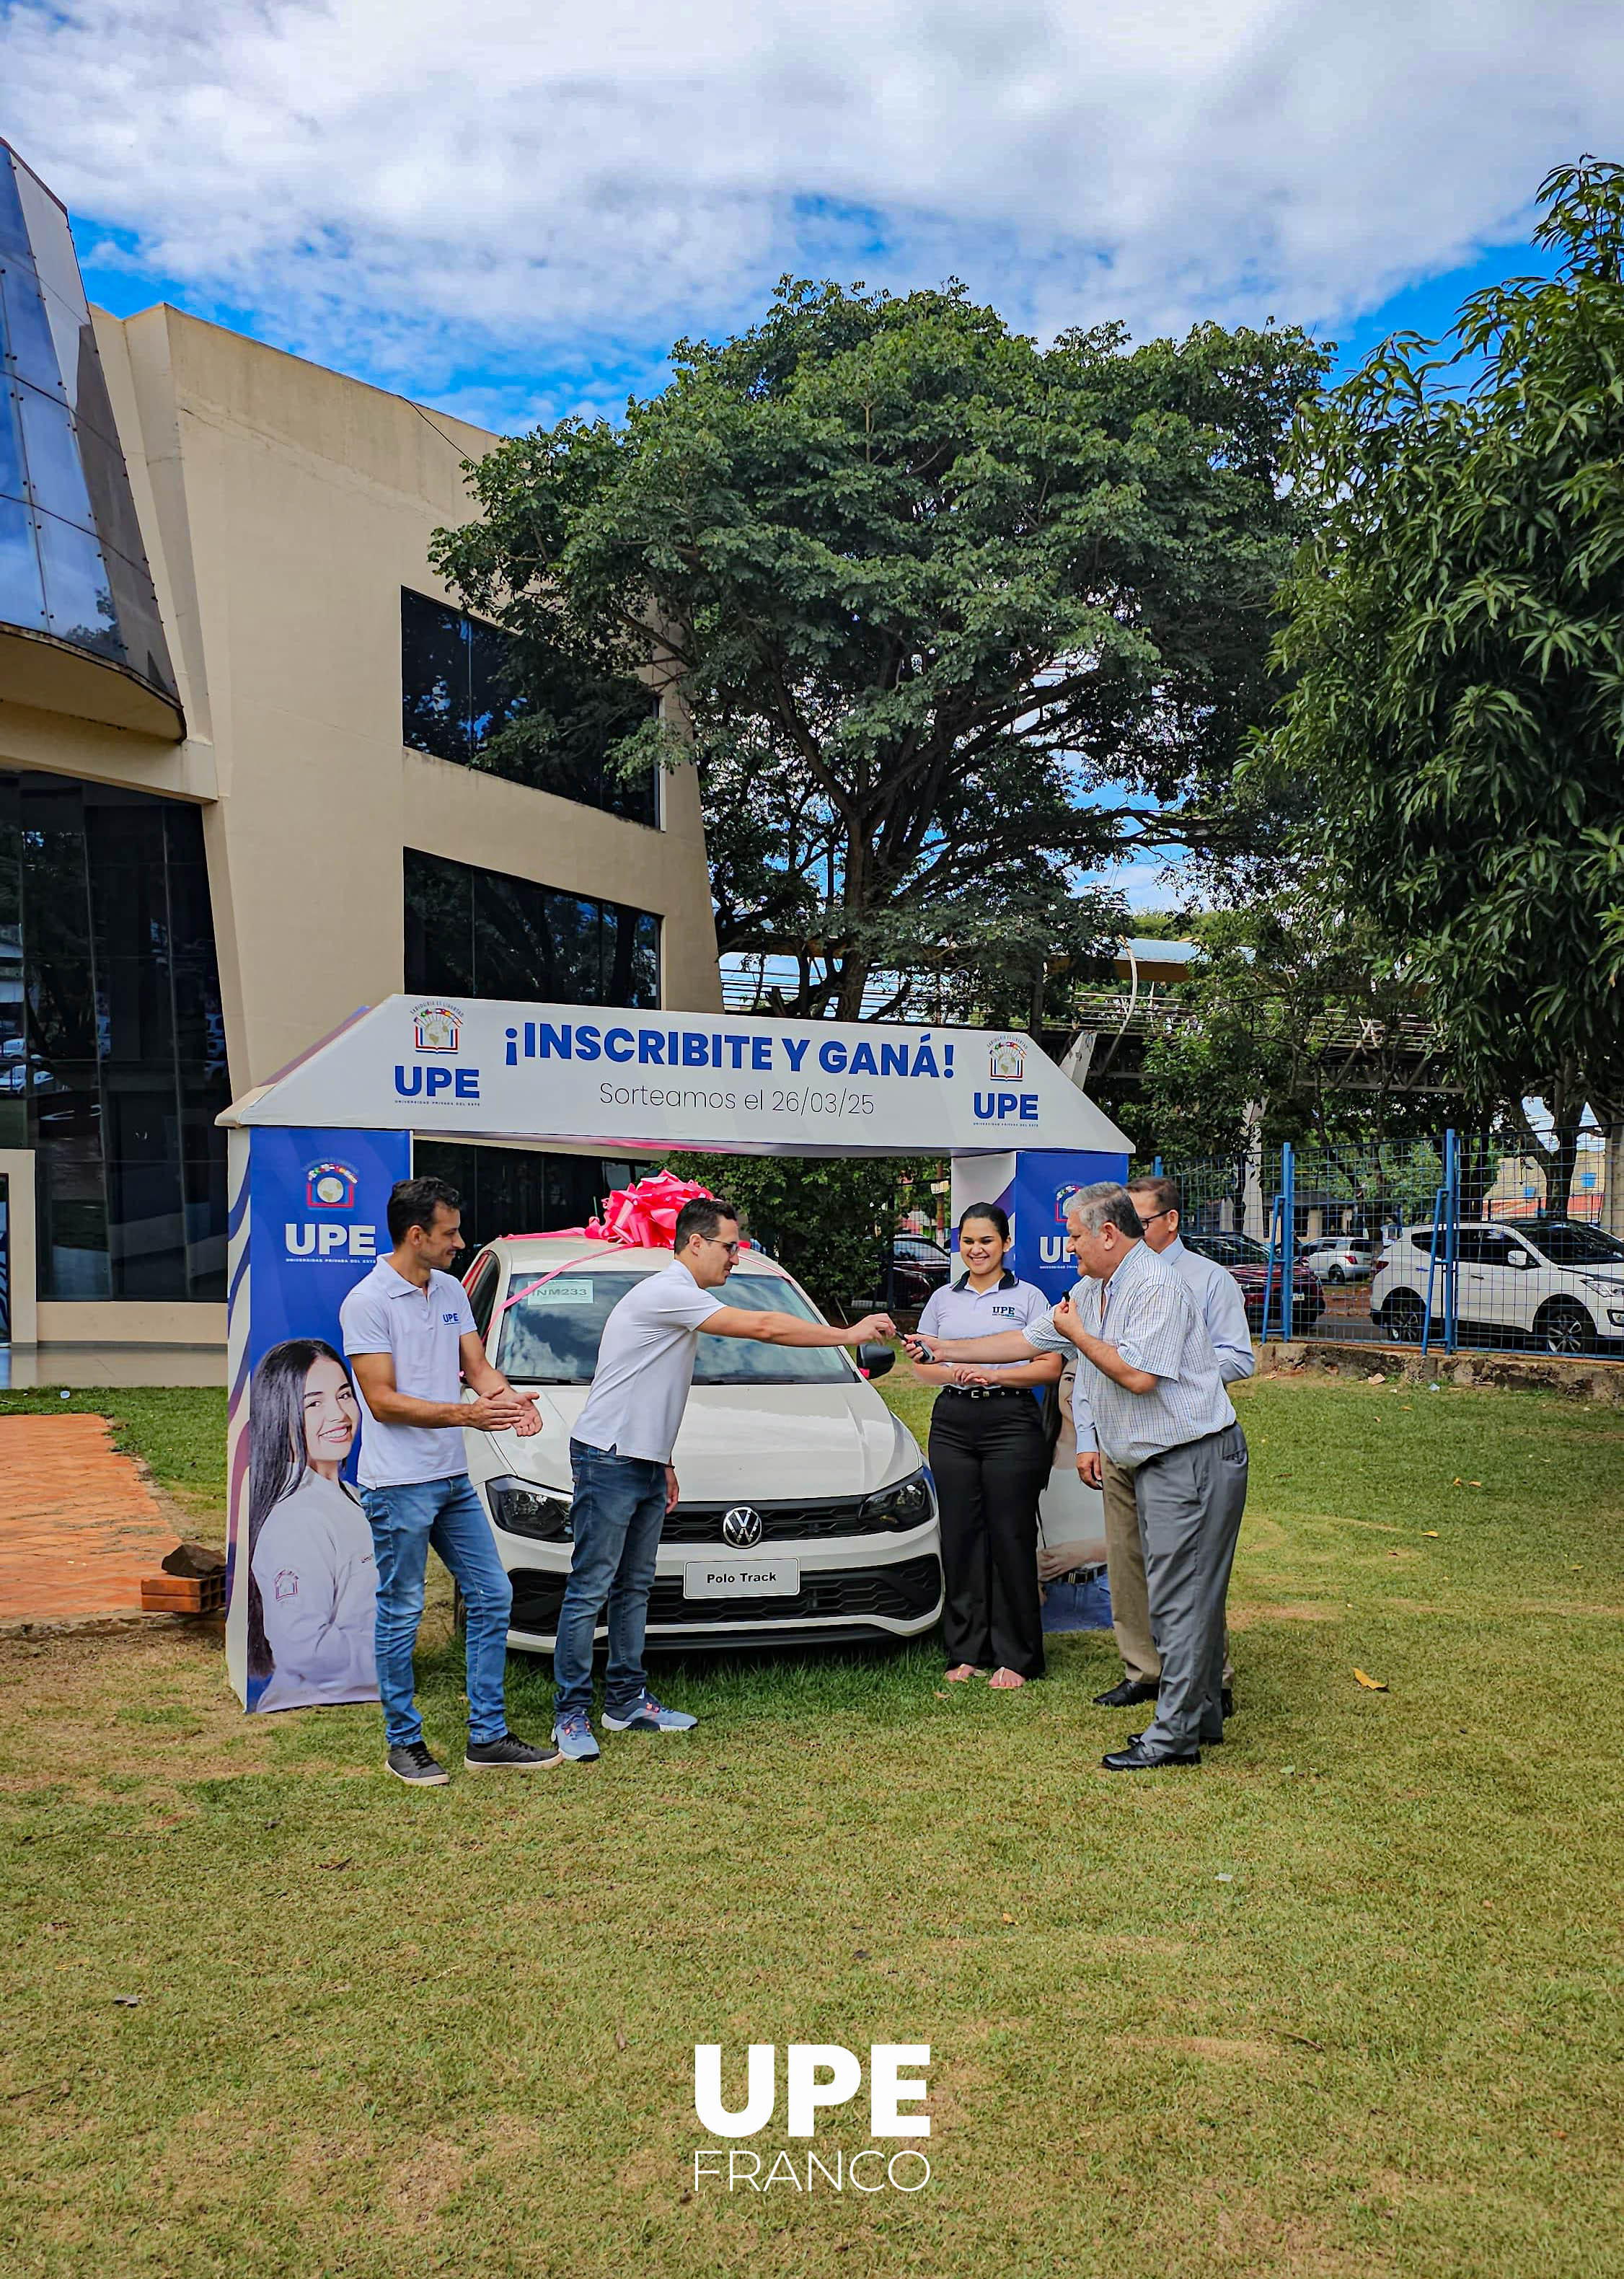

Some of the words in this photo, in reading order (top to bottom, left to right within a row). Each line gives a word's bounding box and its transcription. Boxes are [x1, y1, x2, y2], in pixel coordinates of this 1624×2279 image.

[505, 1022, 773, 1071] ¡INSCRIBITE
[781, 1038, 811, 1072] Y
[818, 1033, 955, 1079] GANÁ!
[394, 1065, 480, 1098] UPE
[599, 1082, 736, 1110] Sorteamos
[744, 1089, 763, 1111] el
[772, 1086, 875, 1118] 26/03/25
[974, 1092, 1038, 1121] UPE
[286, 1223, 376, 1256] UPE
[443, 1313, 459, 1323] UPE
[992, 1306, 1015, 1315] UPE
[707, 1574, 735, 1583] Polo
[740, 1572, 777, 1582] Track
